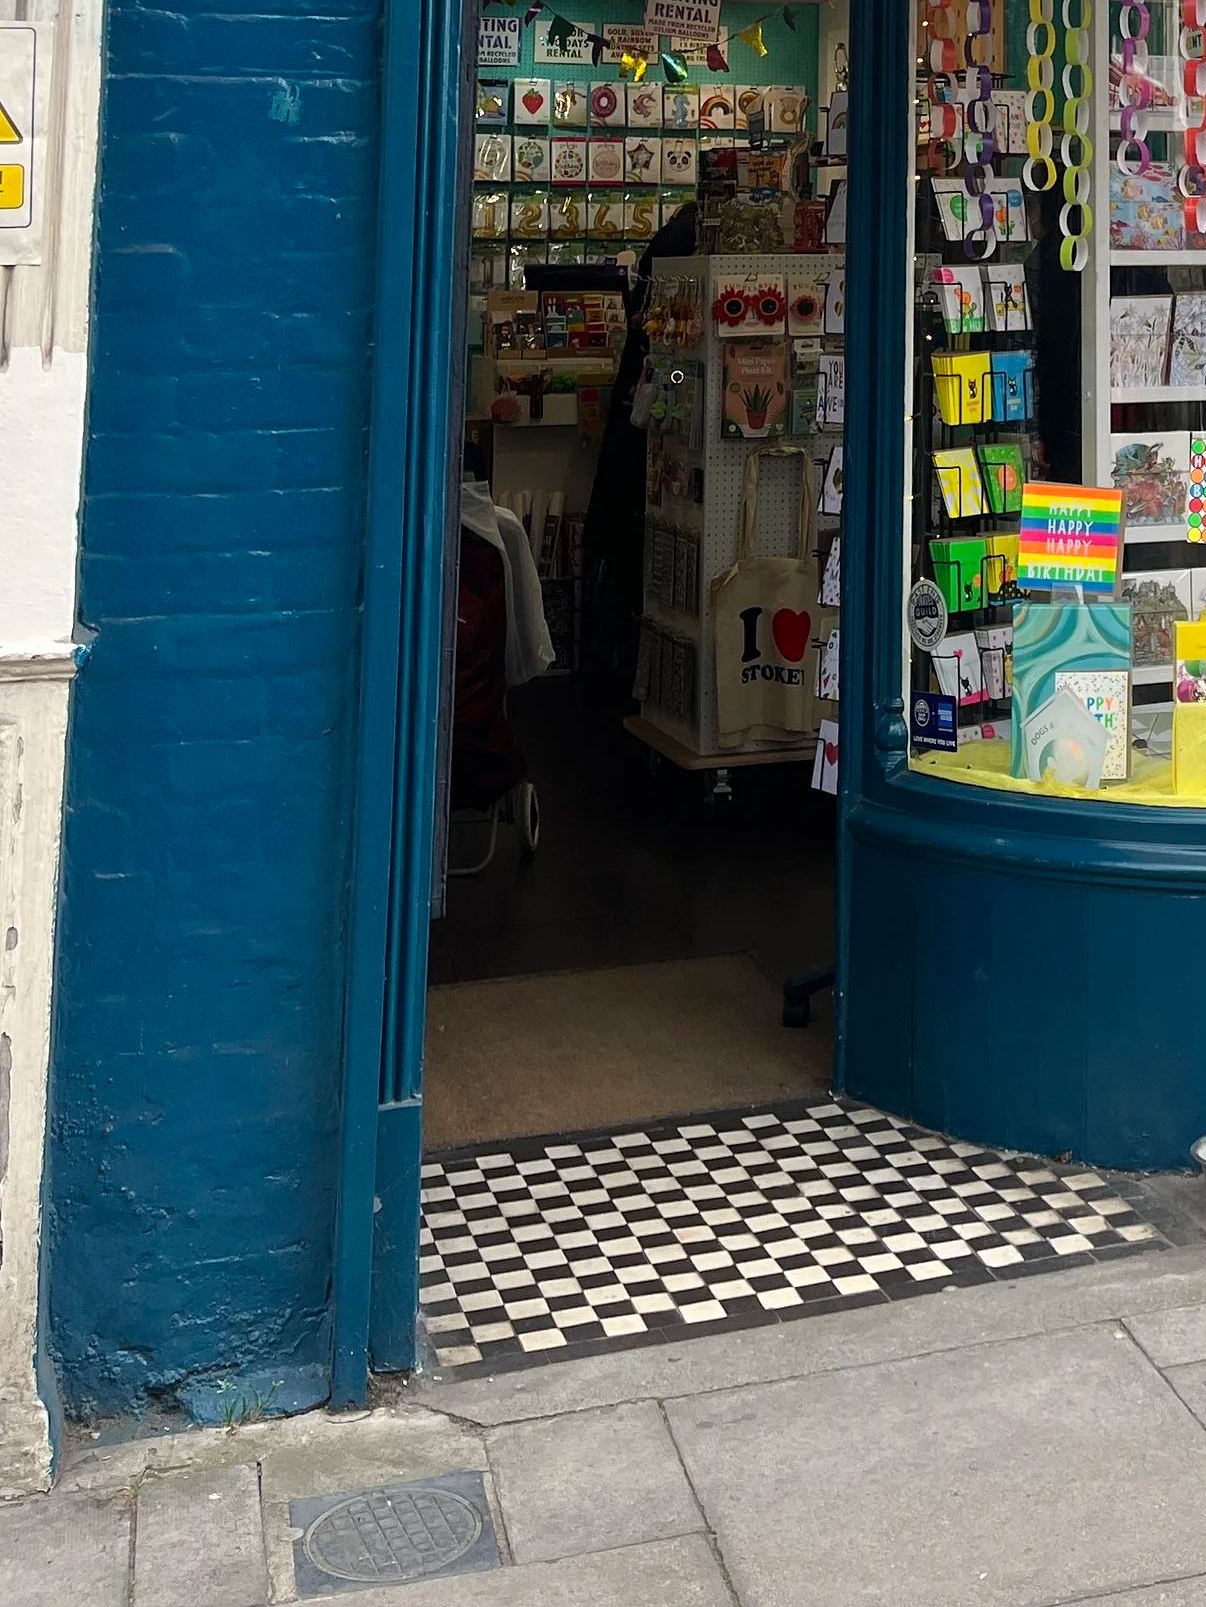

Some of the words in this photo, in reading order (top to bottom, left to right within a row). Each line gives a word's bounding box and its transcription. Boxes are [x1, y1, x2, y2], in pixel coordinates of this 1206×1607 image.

[654, 2, 712, 24] RENTAL
[546, 48, 583, 59] RENTAL
[1049, 500, 1095, 518] HAPPY
[1047, 518, 1094, 537] HAPPY
[1046, 537, 1093, 556] HAPPY
[1027, 559, 1109, 583] BIRTHDAY
[915, 606, 937, 617] GUILD
[739, 607, 763, 663] I
